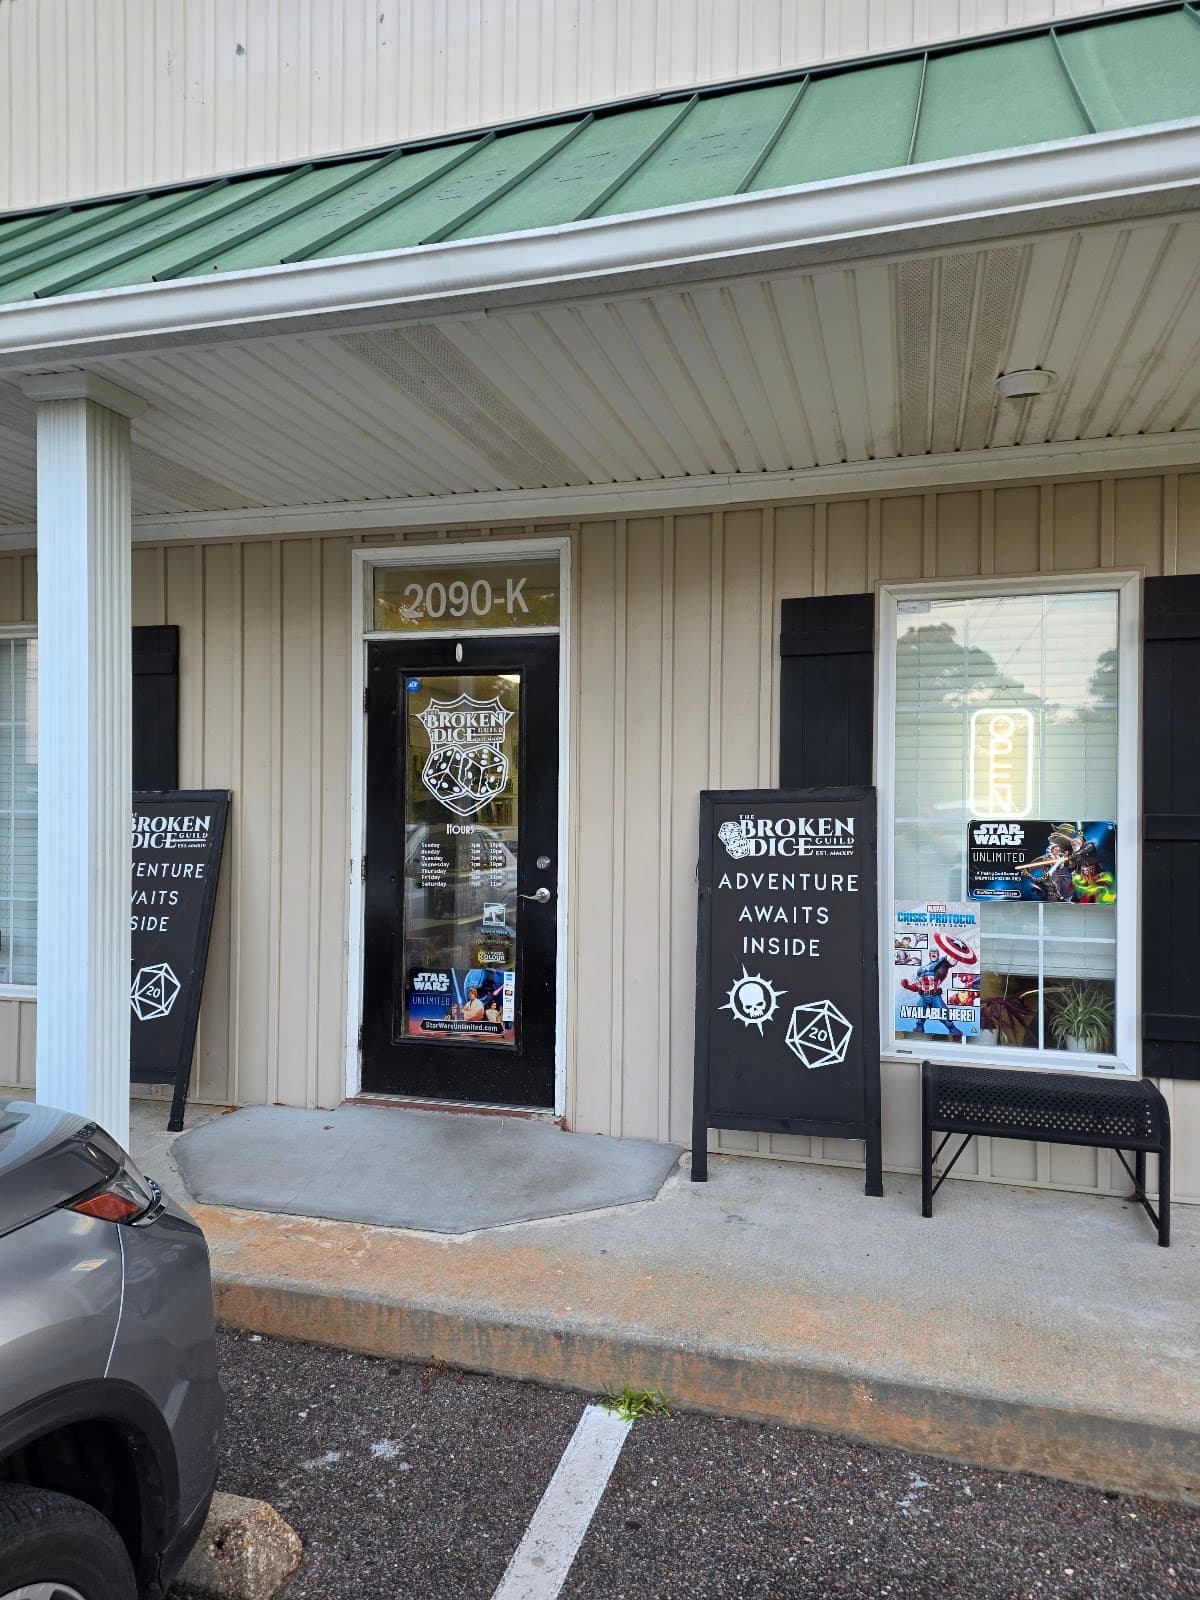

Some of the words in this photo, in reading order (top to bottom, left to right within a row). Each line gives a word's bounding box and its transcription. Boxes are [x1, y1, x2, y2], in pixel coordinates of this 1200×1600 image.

[402, 578, 529, 618] 2090-K
[427, 712, 504, 728] BROKEN
[433, 728, 476, 742] DICE
[989, 714, 1015, 813] OPEN
[739, 818, 855, 837] BROKEN
[973, 824, 1025, 835] STAR
[132, 832, 177, 848] DICE
[748, 837, 813, 856] DICE
[815, 837, 855, 845] GUILD
[973, 834, 1025, 846] WARS
[973, 852, 1025, 863] UNLIMITED
[718, 872, 859, 892] ADVENTURE
[131, 890, 179, 905] AITS
[738, 905, 829, 925] AWAITS
[897, 912, 927, 922] CRISIS
[929, 913, 976, 925] PROTOCOL
[131, 916, 170, 932] SIDE
[743, 936, 820, 956] INSIDE
[413, 973, 450, 982] STAR
[145, 986, 160, 998] 20
[413, 981, 450, 991] WARS
[412, 996, 450, 1006] UNLIMITED
[900, 1005, 947, 1020] AVAILABLE
[425, 1021, 498, 1032] StarWarsUnlimited.com
[808, 1027, 828, 1042] 20
